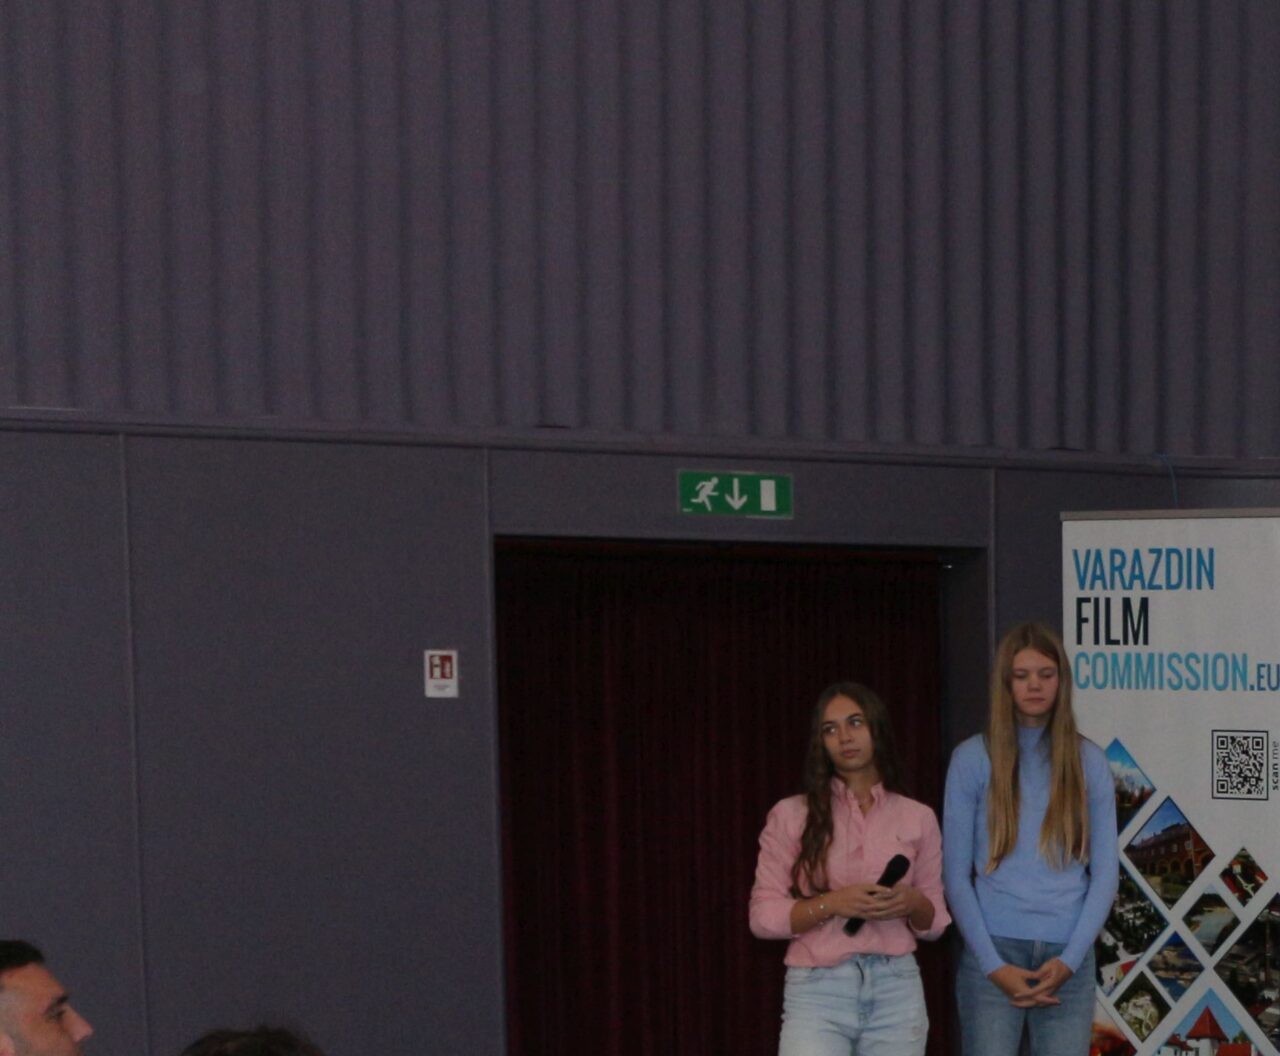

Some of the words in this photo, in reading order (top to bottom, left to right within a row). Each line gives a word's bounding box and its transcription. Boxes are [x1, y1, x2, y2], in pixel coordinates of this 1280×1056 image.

[1072, 547, 1215, 591] VARAZDIN
[1075, 597, 1149, 646] FILM
[1074, 652, 1280, 692] COMMISSION.EU
